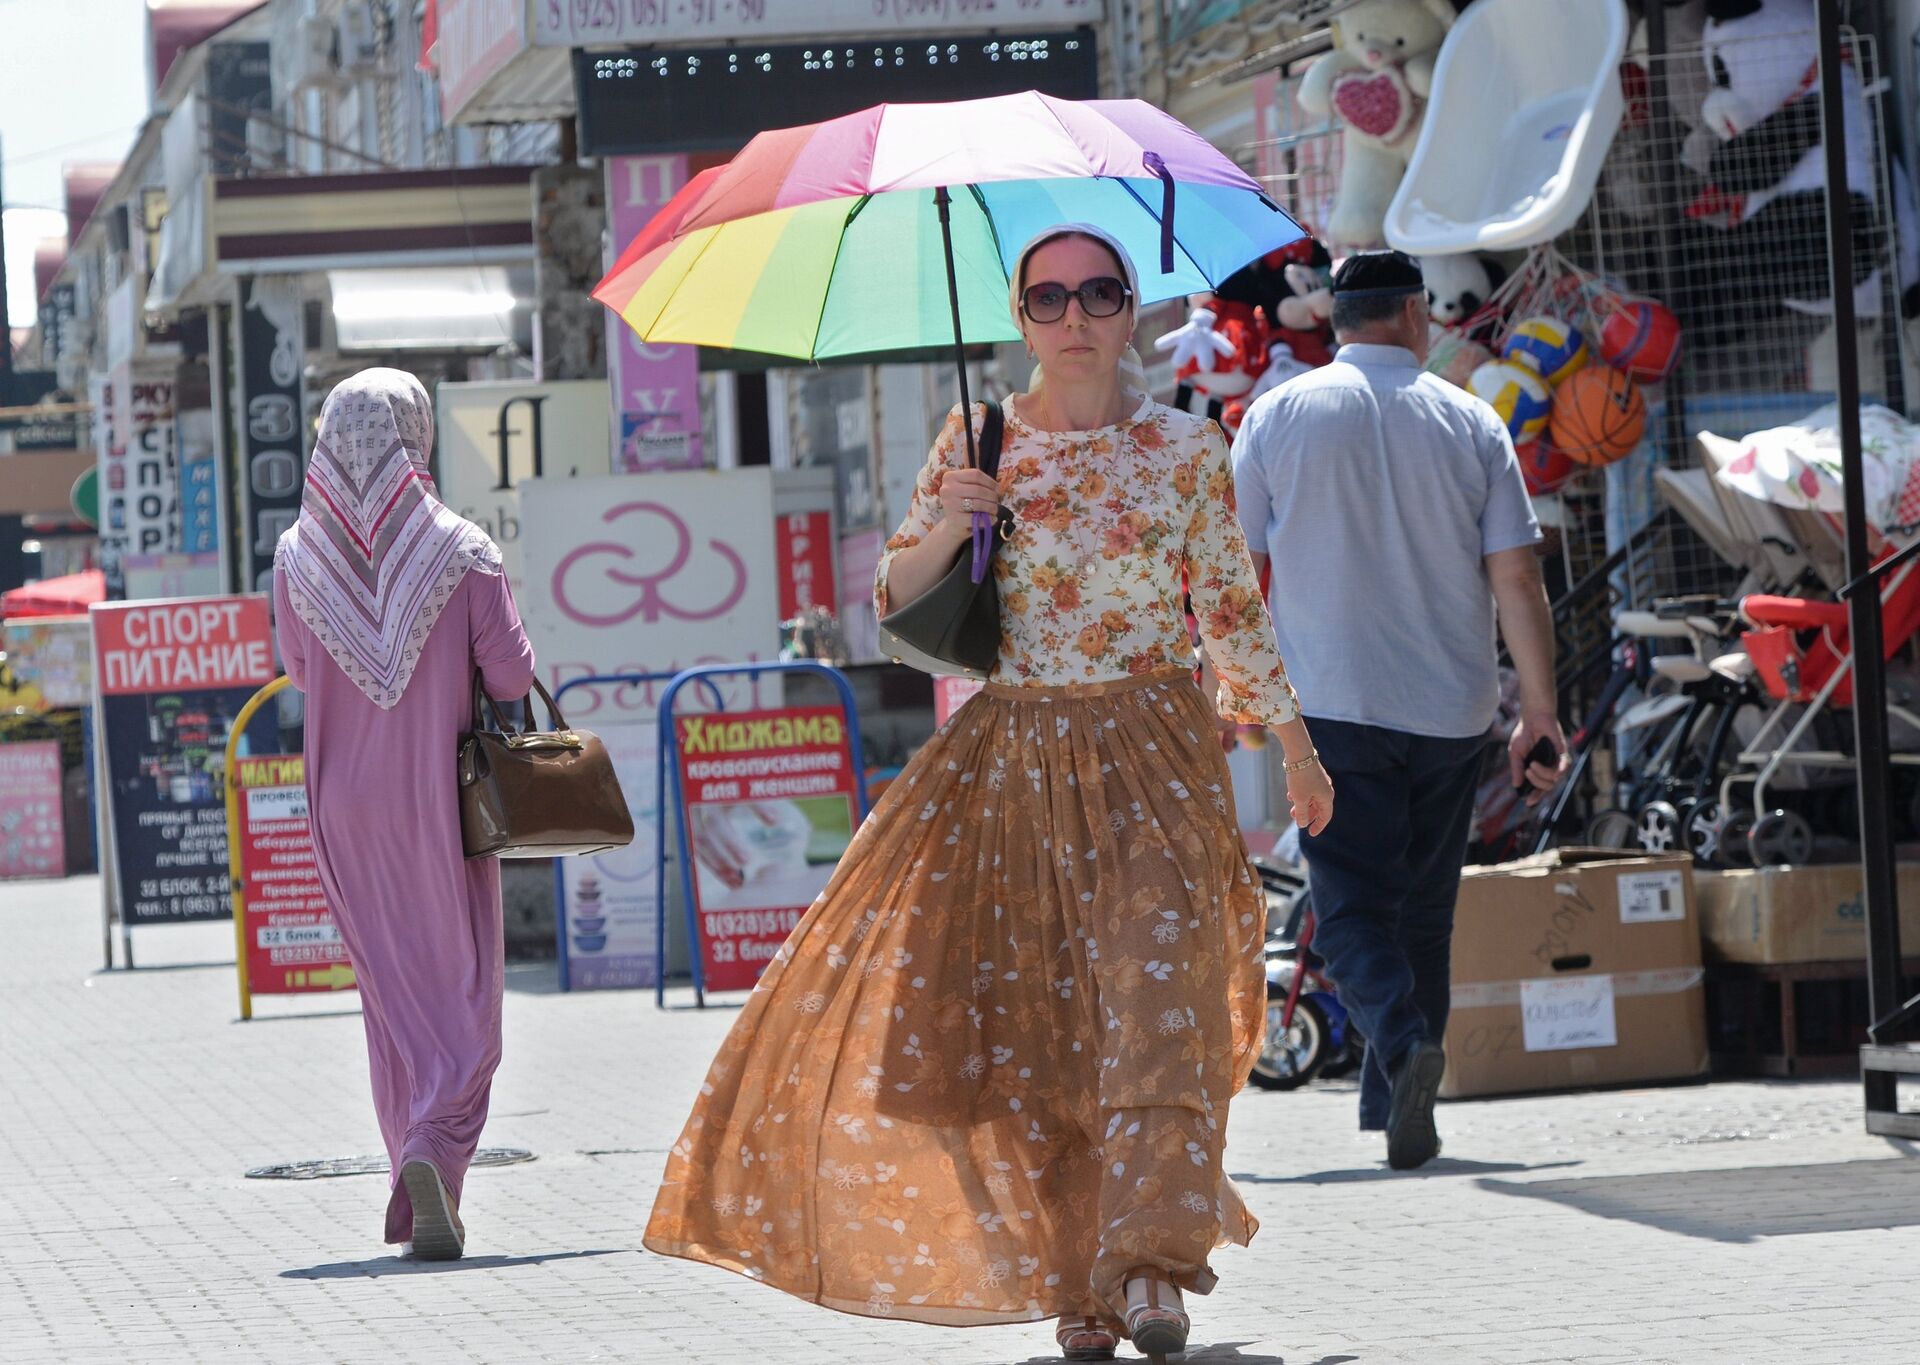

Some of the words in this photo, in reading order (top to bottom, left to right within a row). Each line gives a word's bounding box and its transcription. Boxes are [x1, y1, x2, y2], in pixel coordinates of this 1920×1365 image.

[123, 602, 242, 647] СПОРТ
[104, 641, 271, 688] ПИТАНИЕ
[682, 715, 842, 754] Хиджама
[240, 760, 305, 786] МАГИЯ
[687, 752, 841, 780] кровопускание
[701, 782, 740, 800] для
[749, 774, 837, 797] женщин
[248, 821, 307, 835] Широкий
[140, 880, 159, 898] 32
[713, 940, 736, 962] 32
